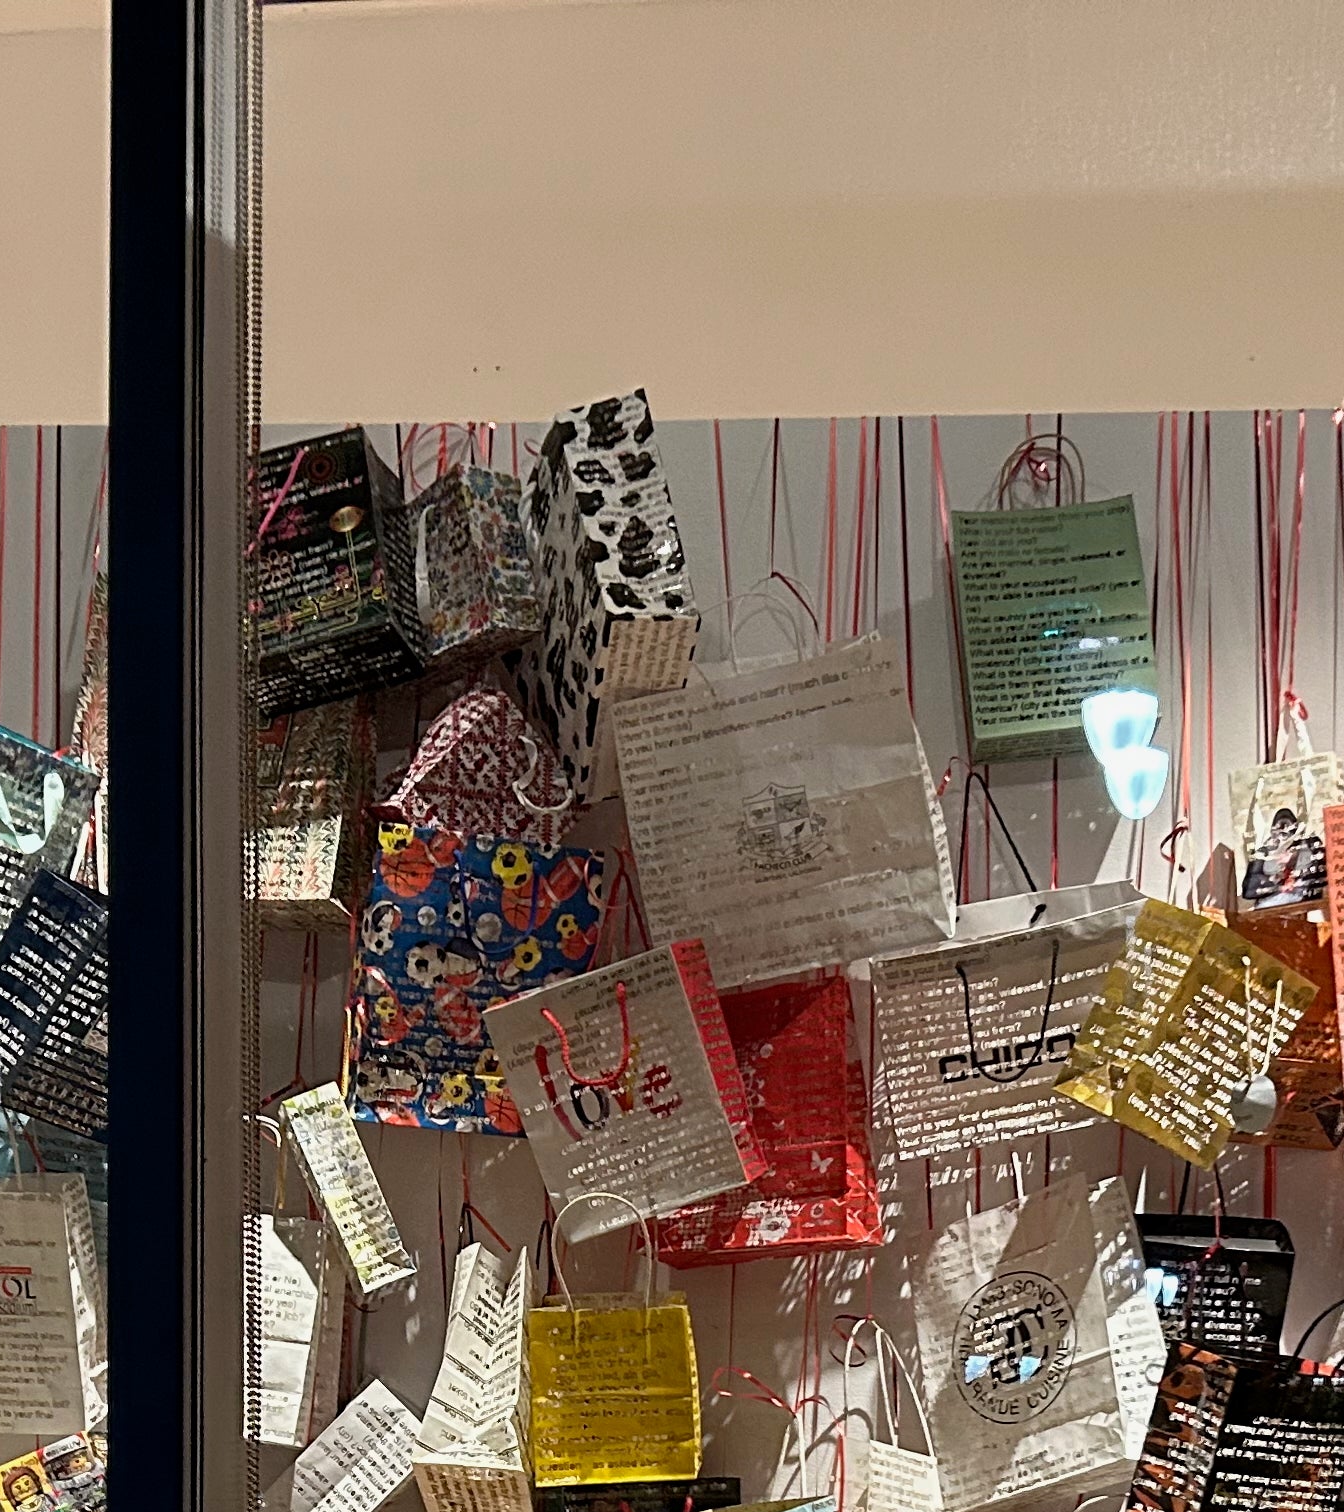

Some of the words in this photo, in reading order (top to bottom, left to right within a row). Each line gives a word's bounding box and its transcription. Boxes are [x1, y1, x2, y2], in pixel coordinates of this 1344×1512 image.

[1209, 1284, 1236, 1297] you?
[282, 1311, 305, 1322] job?
[334, 1423, 355, 1444] (city
[330, 1436, 355, 1462] place
[349, 1440, 390, 1480] residence?
[360, 1433, 393, 1466] country)
[350, 1456, 389, 1495] permanent
[384, 1475, 396, 1487] of
[387, 1461, 405, 1479] and
[340, 1481, 373, 1512] religion)
